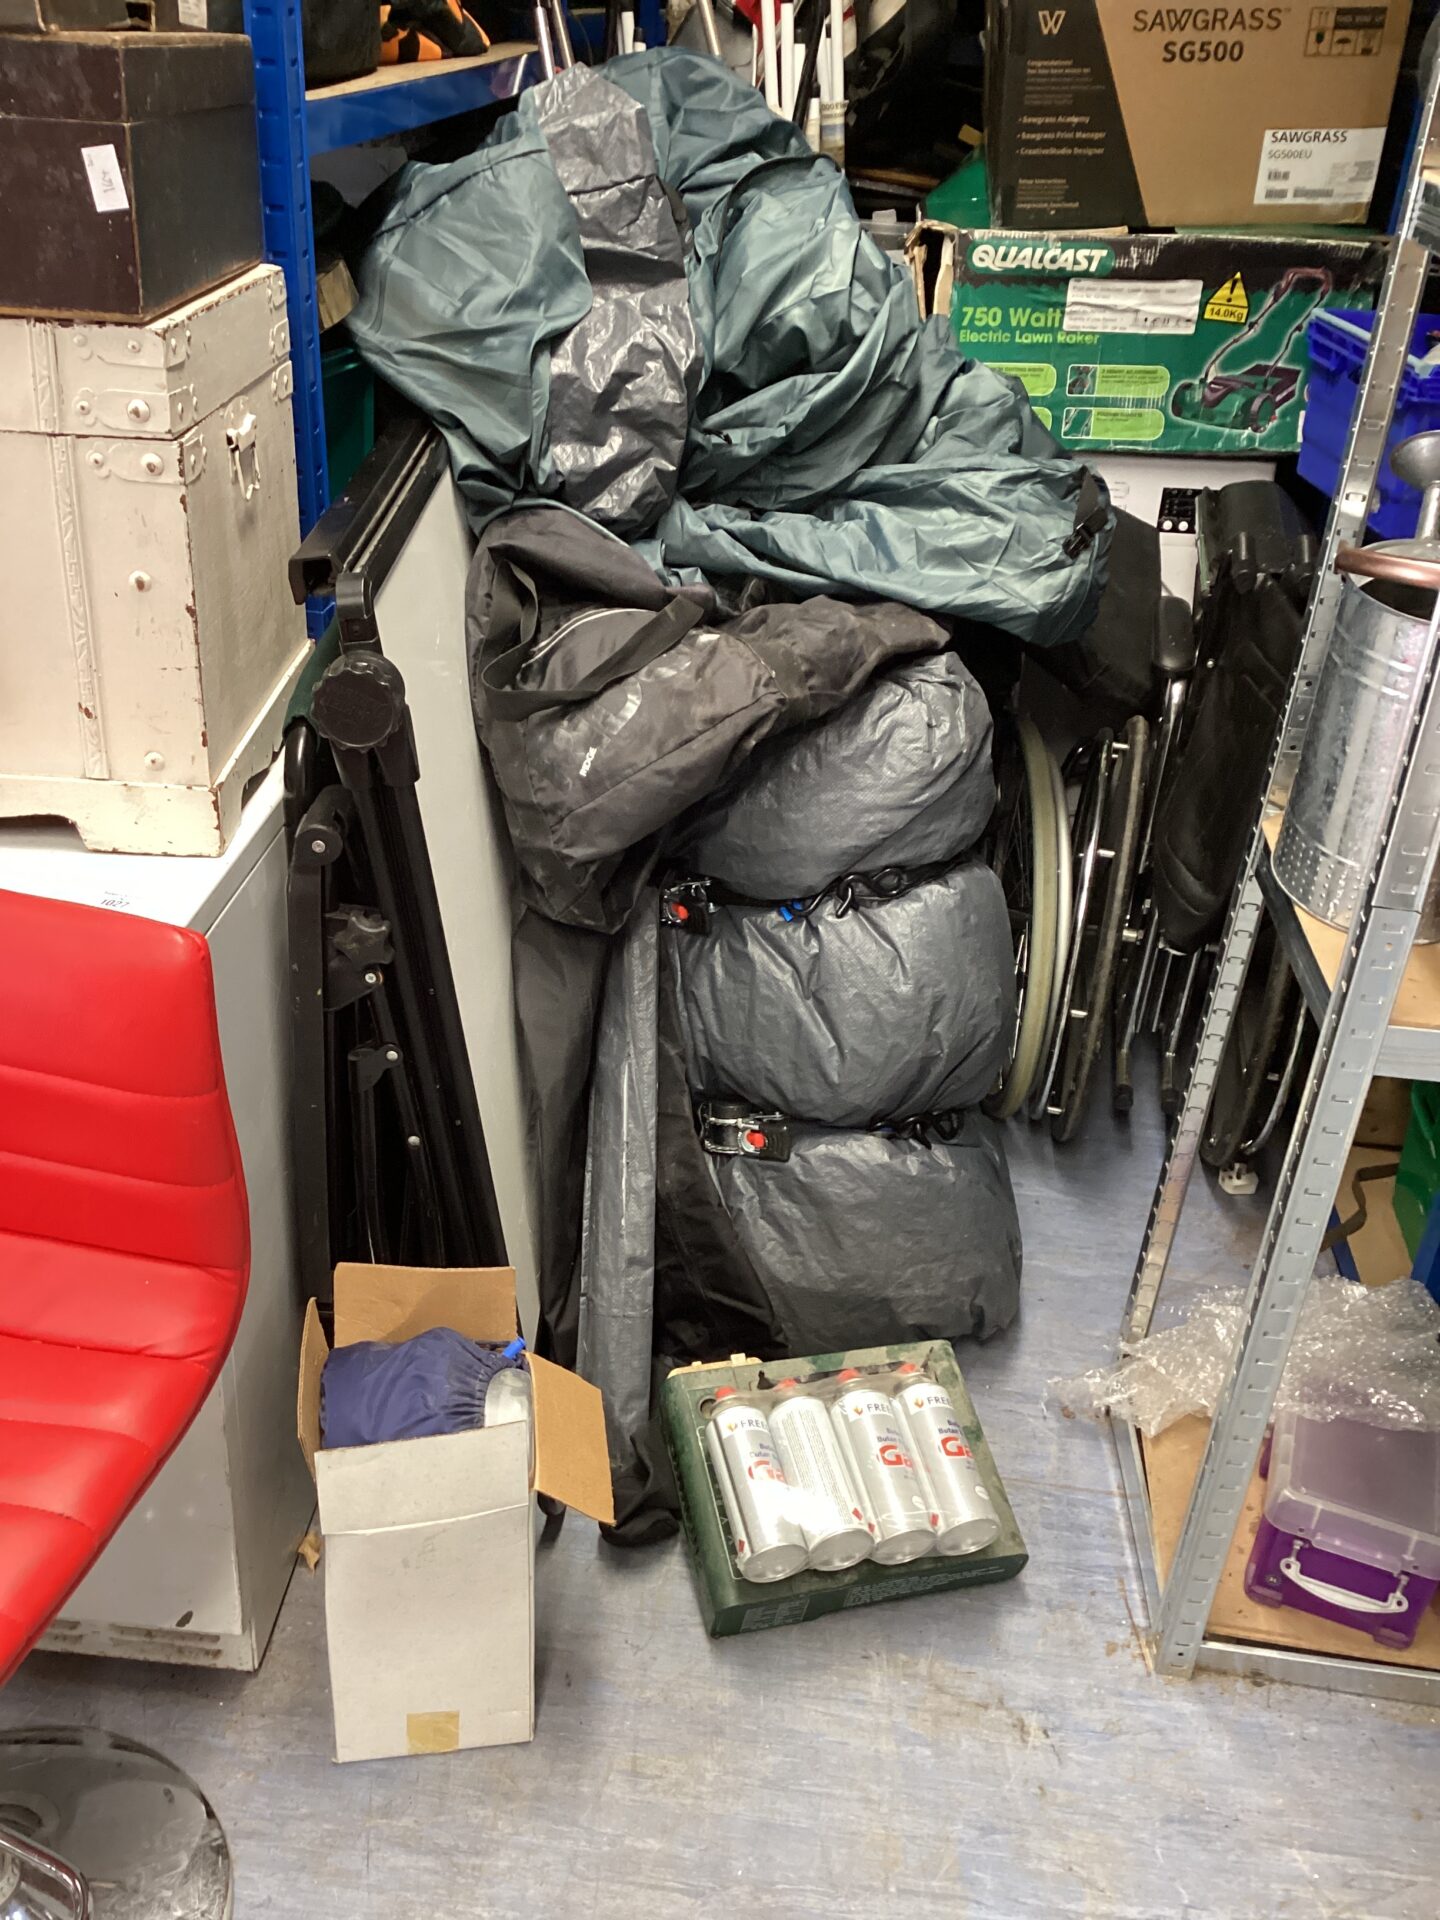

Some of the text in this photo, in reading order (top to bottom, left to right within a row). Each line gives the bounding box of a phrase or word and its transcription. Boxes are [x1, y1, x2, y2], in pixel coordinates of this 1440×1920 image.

[1132, 7, 1283, 33] SAWGRASS
[1162, 40, 1245, 63] SG500
[1271, 131, 1348, 143] SAWGRASS
[971, 244, 1109, 273] QUALCAST
[961, 306, 1063, 328] 750 Watt
[959, 330, 1100, 345] Electric Lawn Raker
